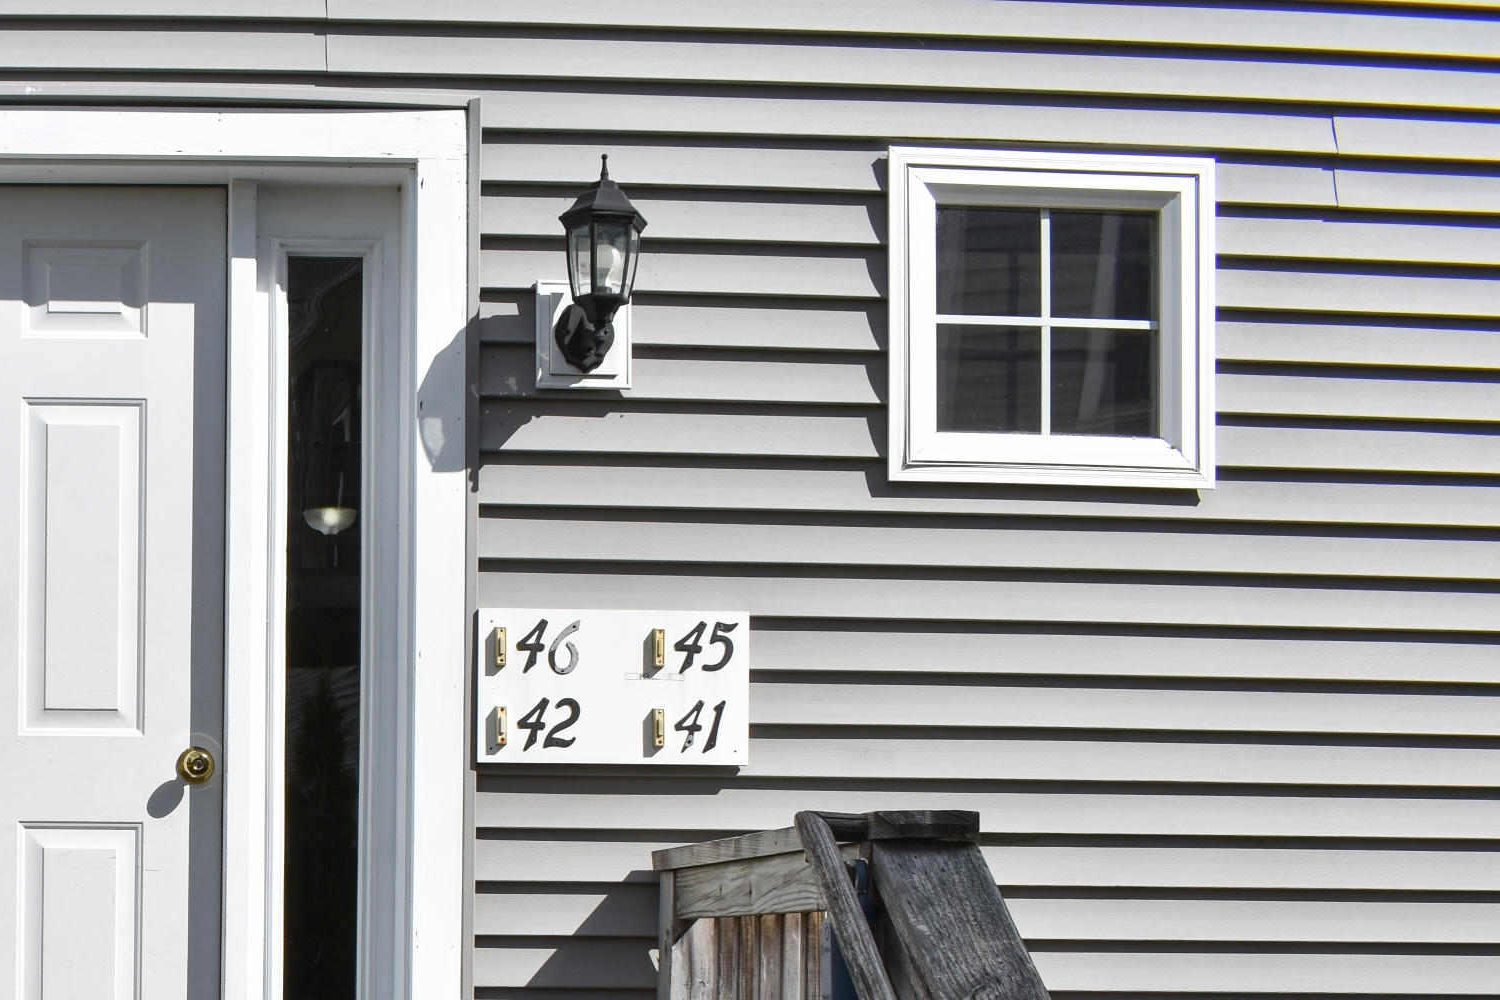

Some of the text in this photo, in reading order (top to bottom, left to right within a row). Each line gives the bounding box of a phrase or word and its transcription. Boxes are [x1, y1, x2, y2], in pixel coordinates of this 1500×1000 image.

[516, 618, 581, 675] 46
[673, 620, 739, 674] 45
[516, 697, 581, 752] 42
[674, 699, 727, 754] 41
